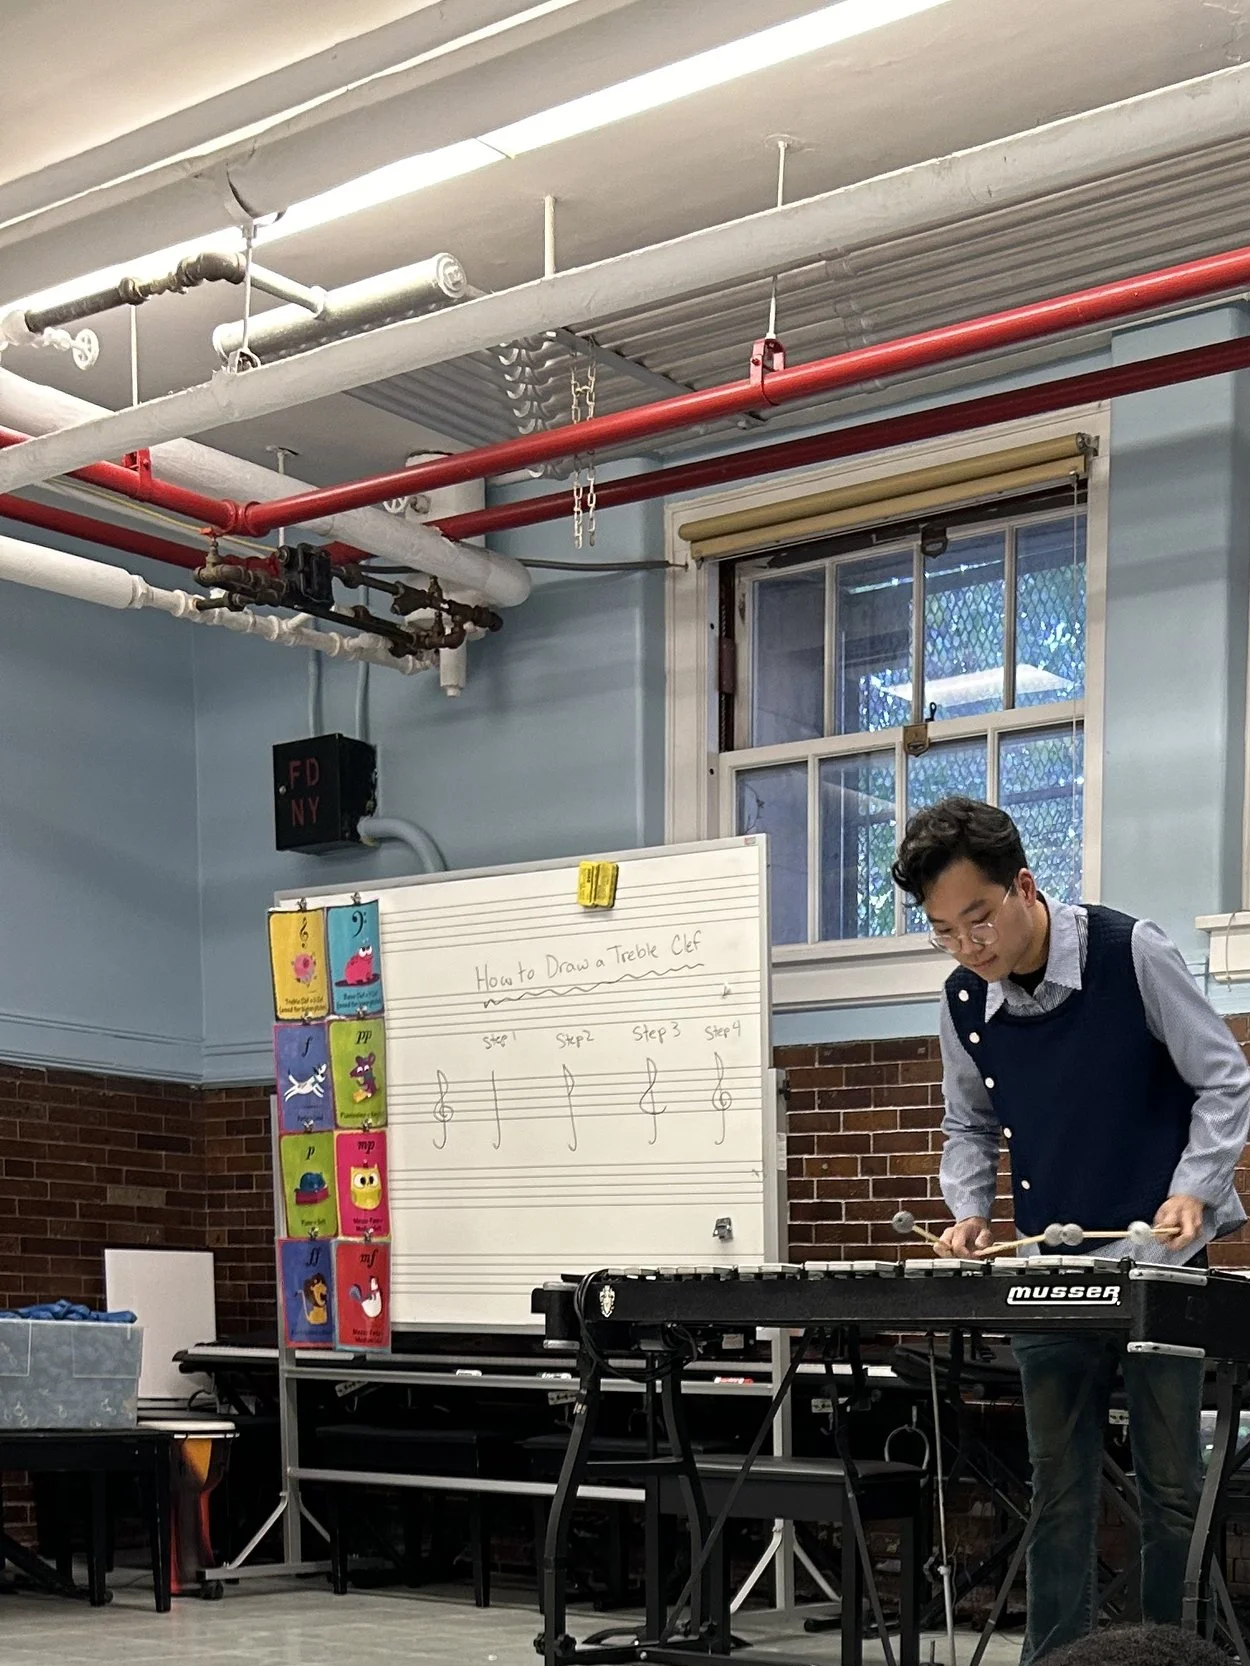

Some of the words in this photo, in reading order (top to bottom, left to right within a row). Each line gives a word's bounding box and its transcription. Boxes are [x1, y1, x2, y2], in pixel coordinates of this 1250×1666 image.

[289, 757, 320, 790] FD
[290, 796, 320, 828] NY
[475, 963, 513, 992] How
[518, 961, 535, 983] to
[546, 954, 590, 979] Draw
[596, 958, 605, 968] a
[607, 943, 659, 965] Treble
[671, 930, 702, 956] Clef
[354, 1030, 373, 1045] pp
[632, 1024, 667, 1044] Step
[671, 1021, 681, 1038] 3
[305, 1146, 316, 1160] p
[358, 1140, 376, 1154] mp
[359, 1248, 379, 1269] mf
